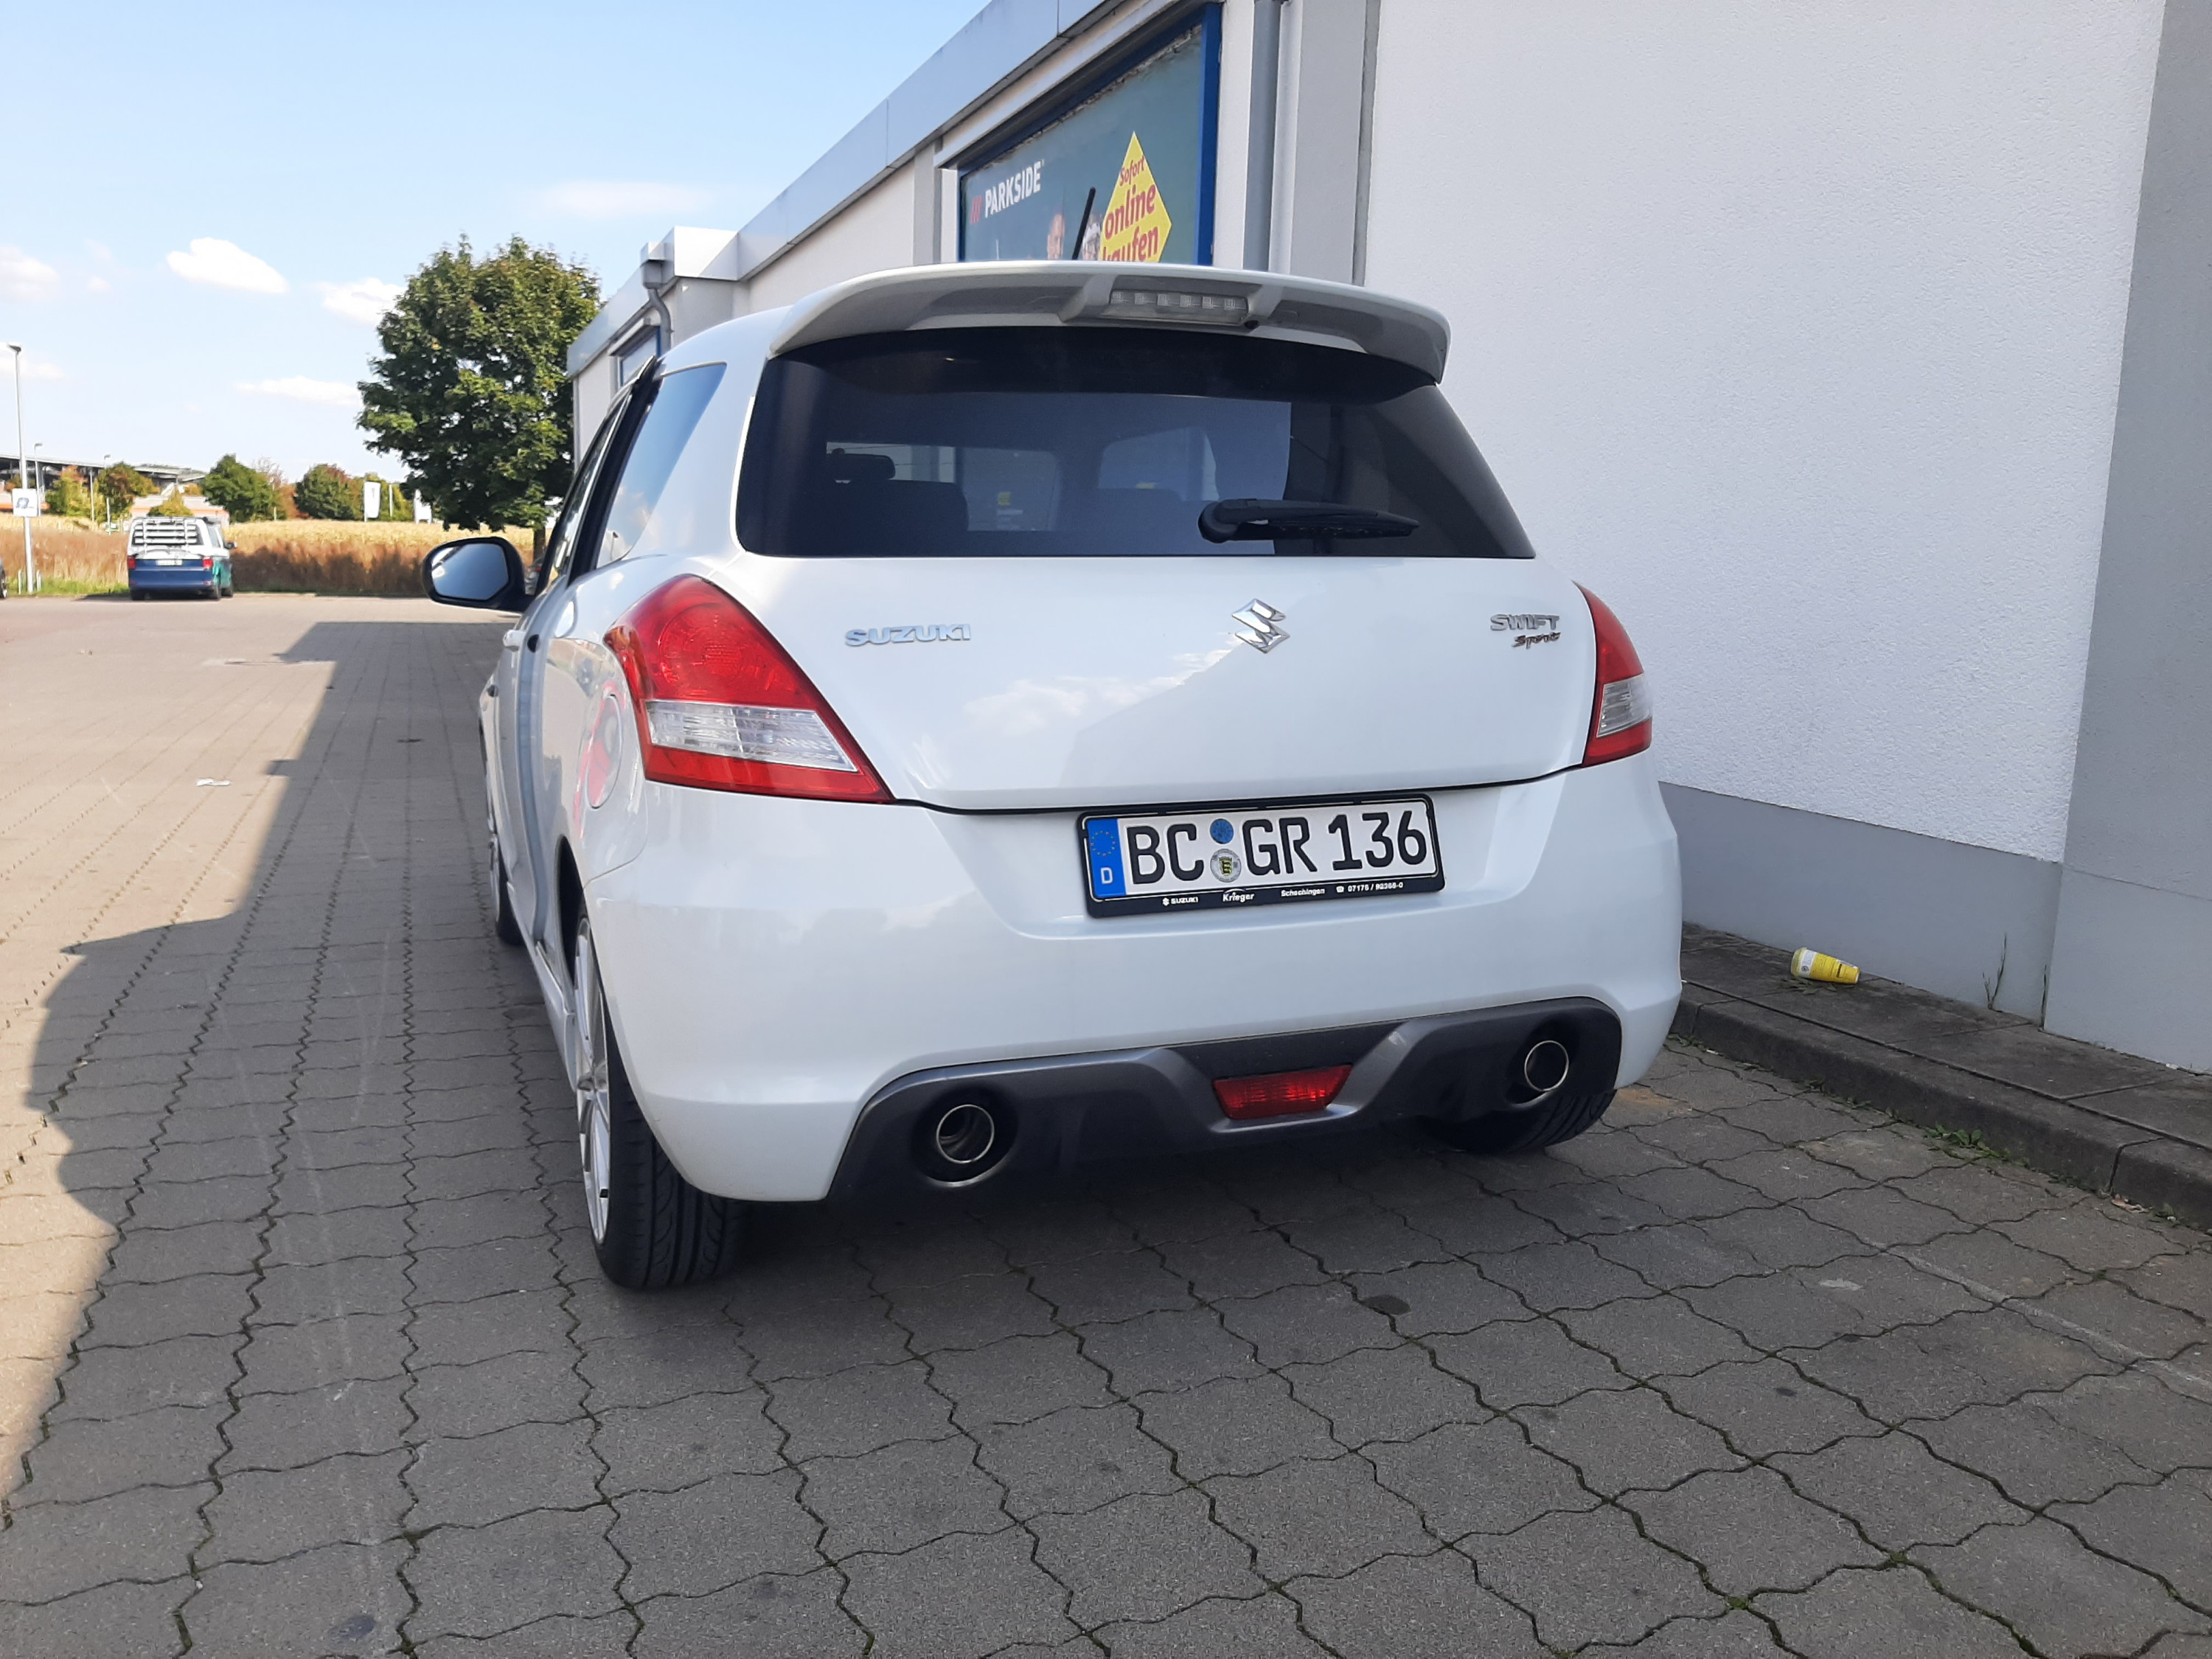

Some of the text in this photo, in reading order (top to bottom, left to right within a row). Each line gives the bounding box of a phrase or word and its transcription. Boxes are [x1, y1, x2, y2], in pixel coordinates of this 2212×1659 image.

[1119, 156, 1144, 186] Sofort
[984, 161, 1041, 218] PARKSIDE
[1105, 184, 1156, 240] online
[1490, 613, 1559, 631] SWIFT
[845, 624, 971, 647] SUZUKI
[1512, 632, 1561, 650] Sport
[1127, 824, 1204, 884] BC
[1242, 816, 1318, 876] GR
[1328, 810, 1427, 871] 136
[1101, 867, 1113, 884] D
[1170, 897, 1199, 905] SUZUKI
[1222, 892, 1255, 903] Krieger
